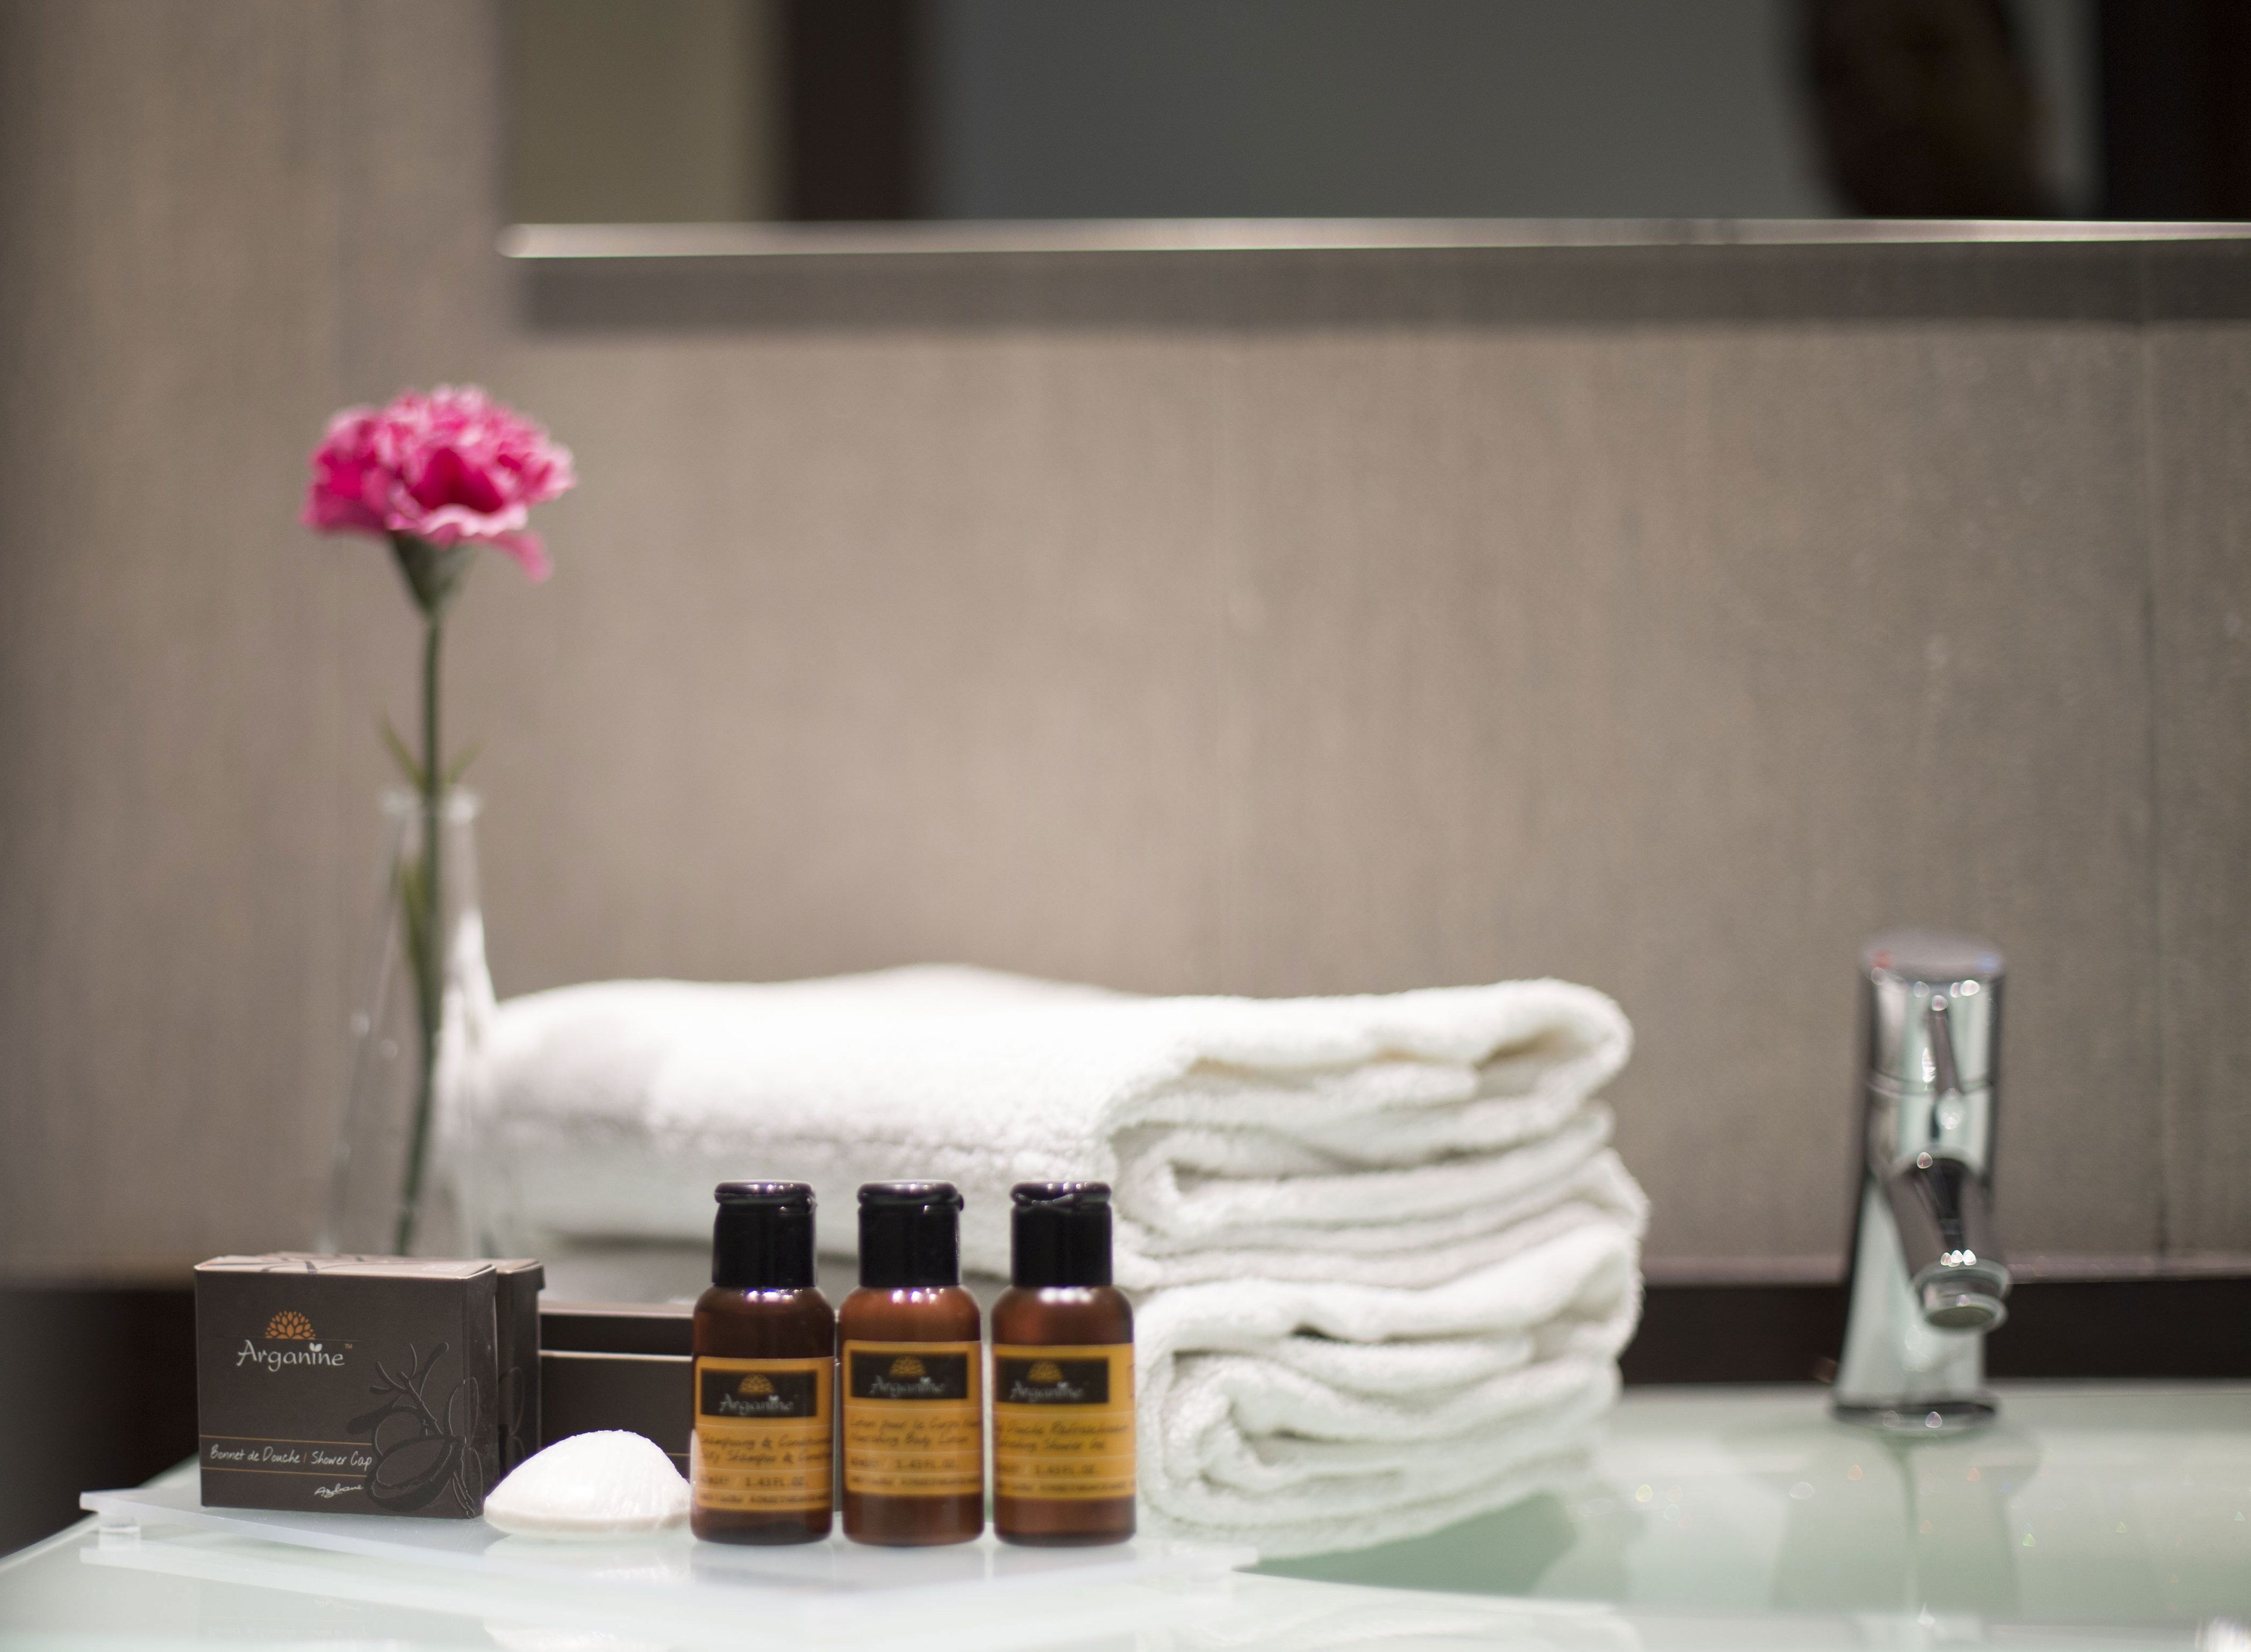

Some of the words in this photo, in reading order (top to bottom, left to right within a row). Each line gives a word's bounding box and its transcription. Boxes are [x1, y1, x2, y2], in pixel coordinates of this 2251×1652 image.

[236, 1339, 345, 1372] Arganine
[719, 1392, 794, 1416] Arganine
[210, 1443, 244, 1459] Bonnet
[247, 1449, 260, 1462] de
[263, 1446, 300, 1463] Douche
[310, 1450, 347, 1466] Shower
[351, 1450, 373, 1472] Cap
